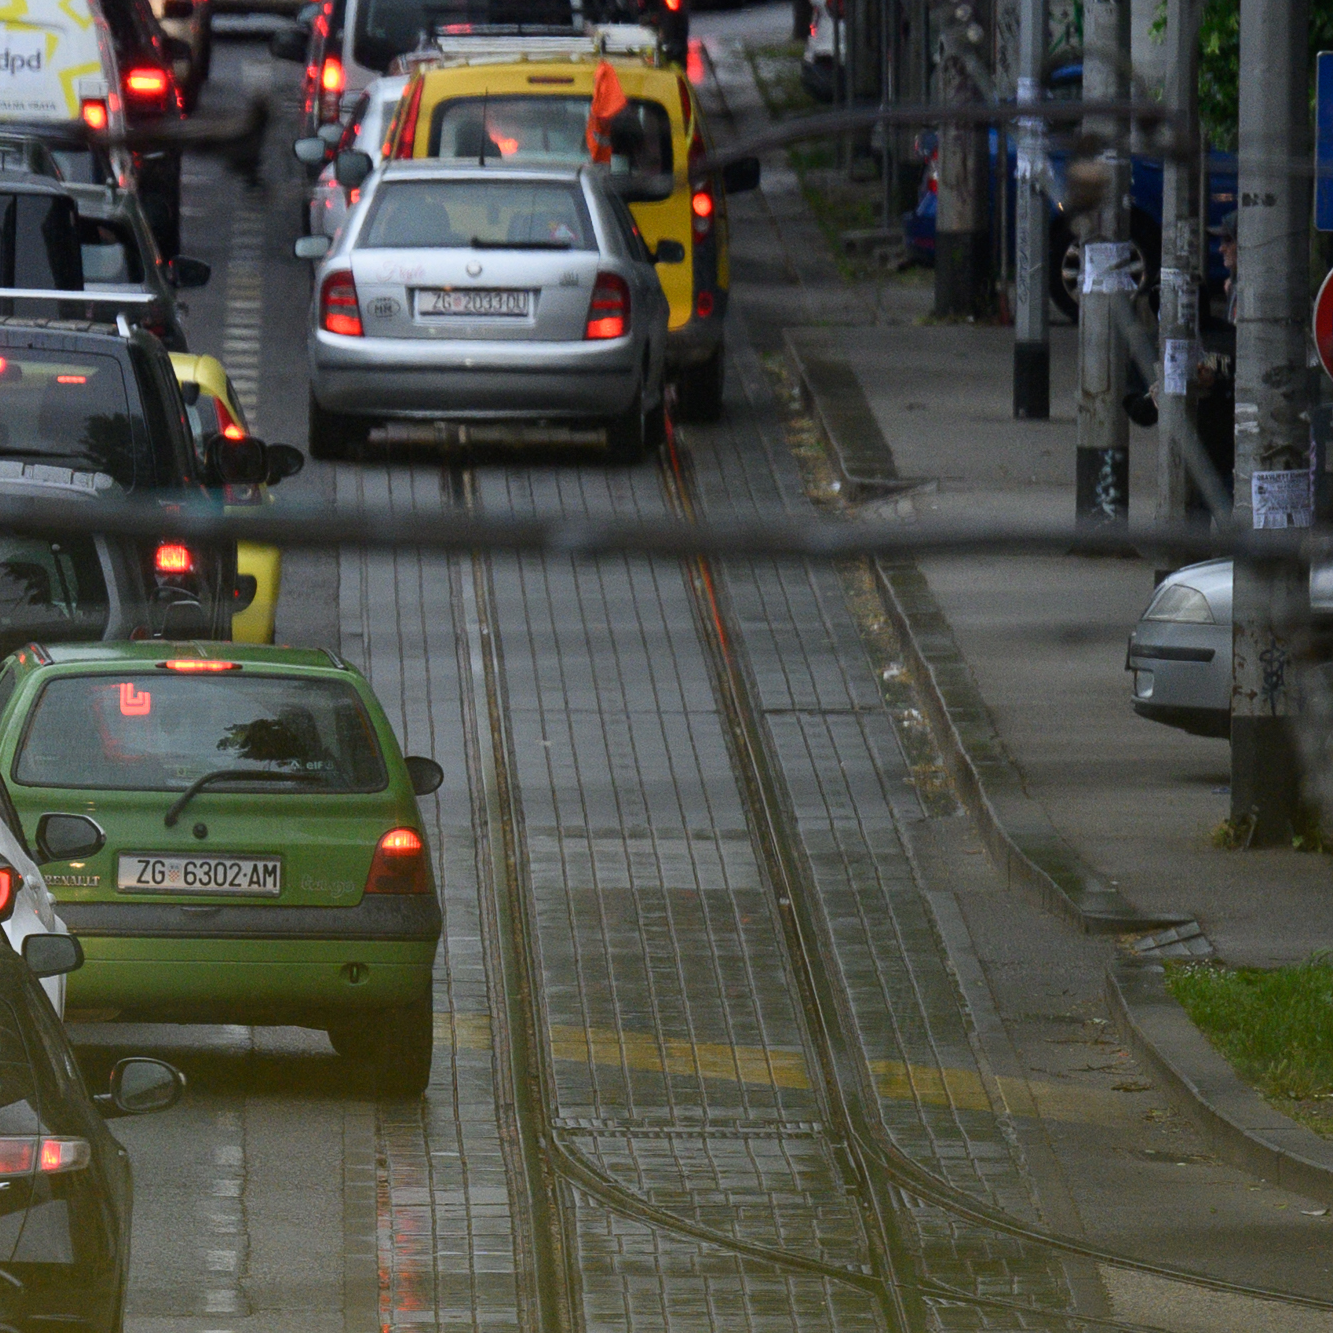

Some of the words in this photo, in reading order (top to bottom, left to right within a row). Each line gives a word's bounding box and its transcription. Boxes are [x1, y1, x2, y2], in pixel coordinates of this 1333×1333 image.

[433, 292, 452, 310] ZG
[43, 874, 101, 887] RENAULT
[136, 859, 166, 885] ZG
